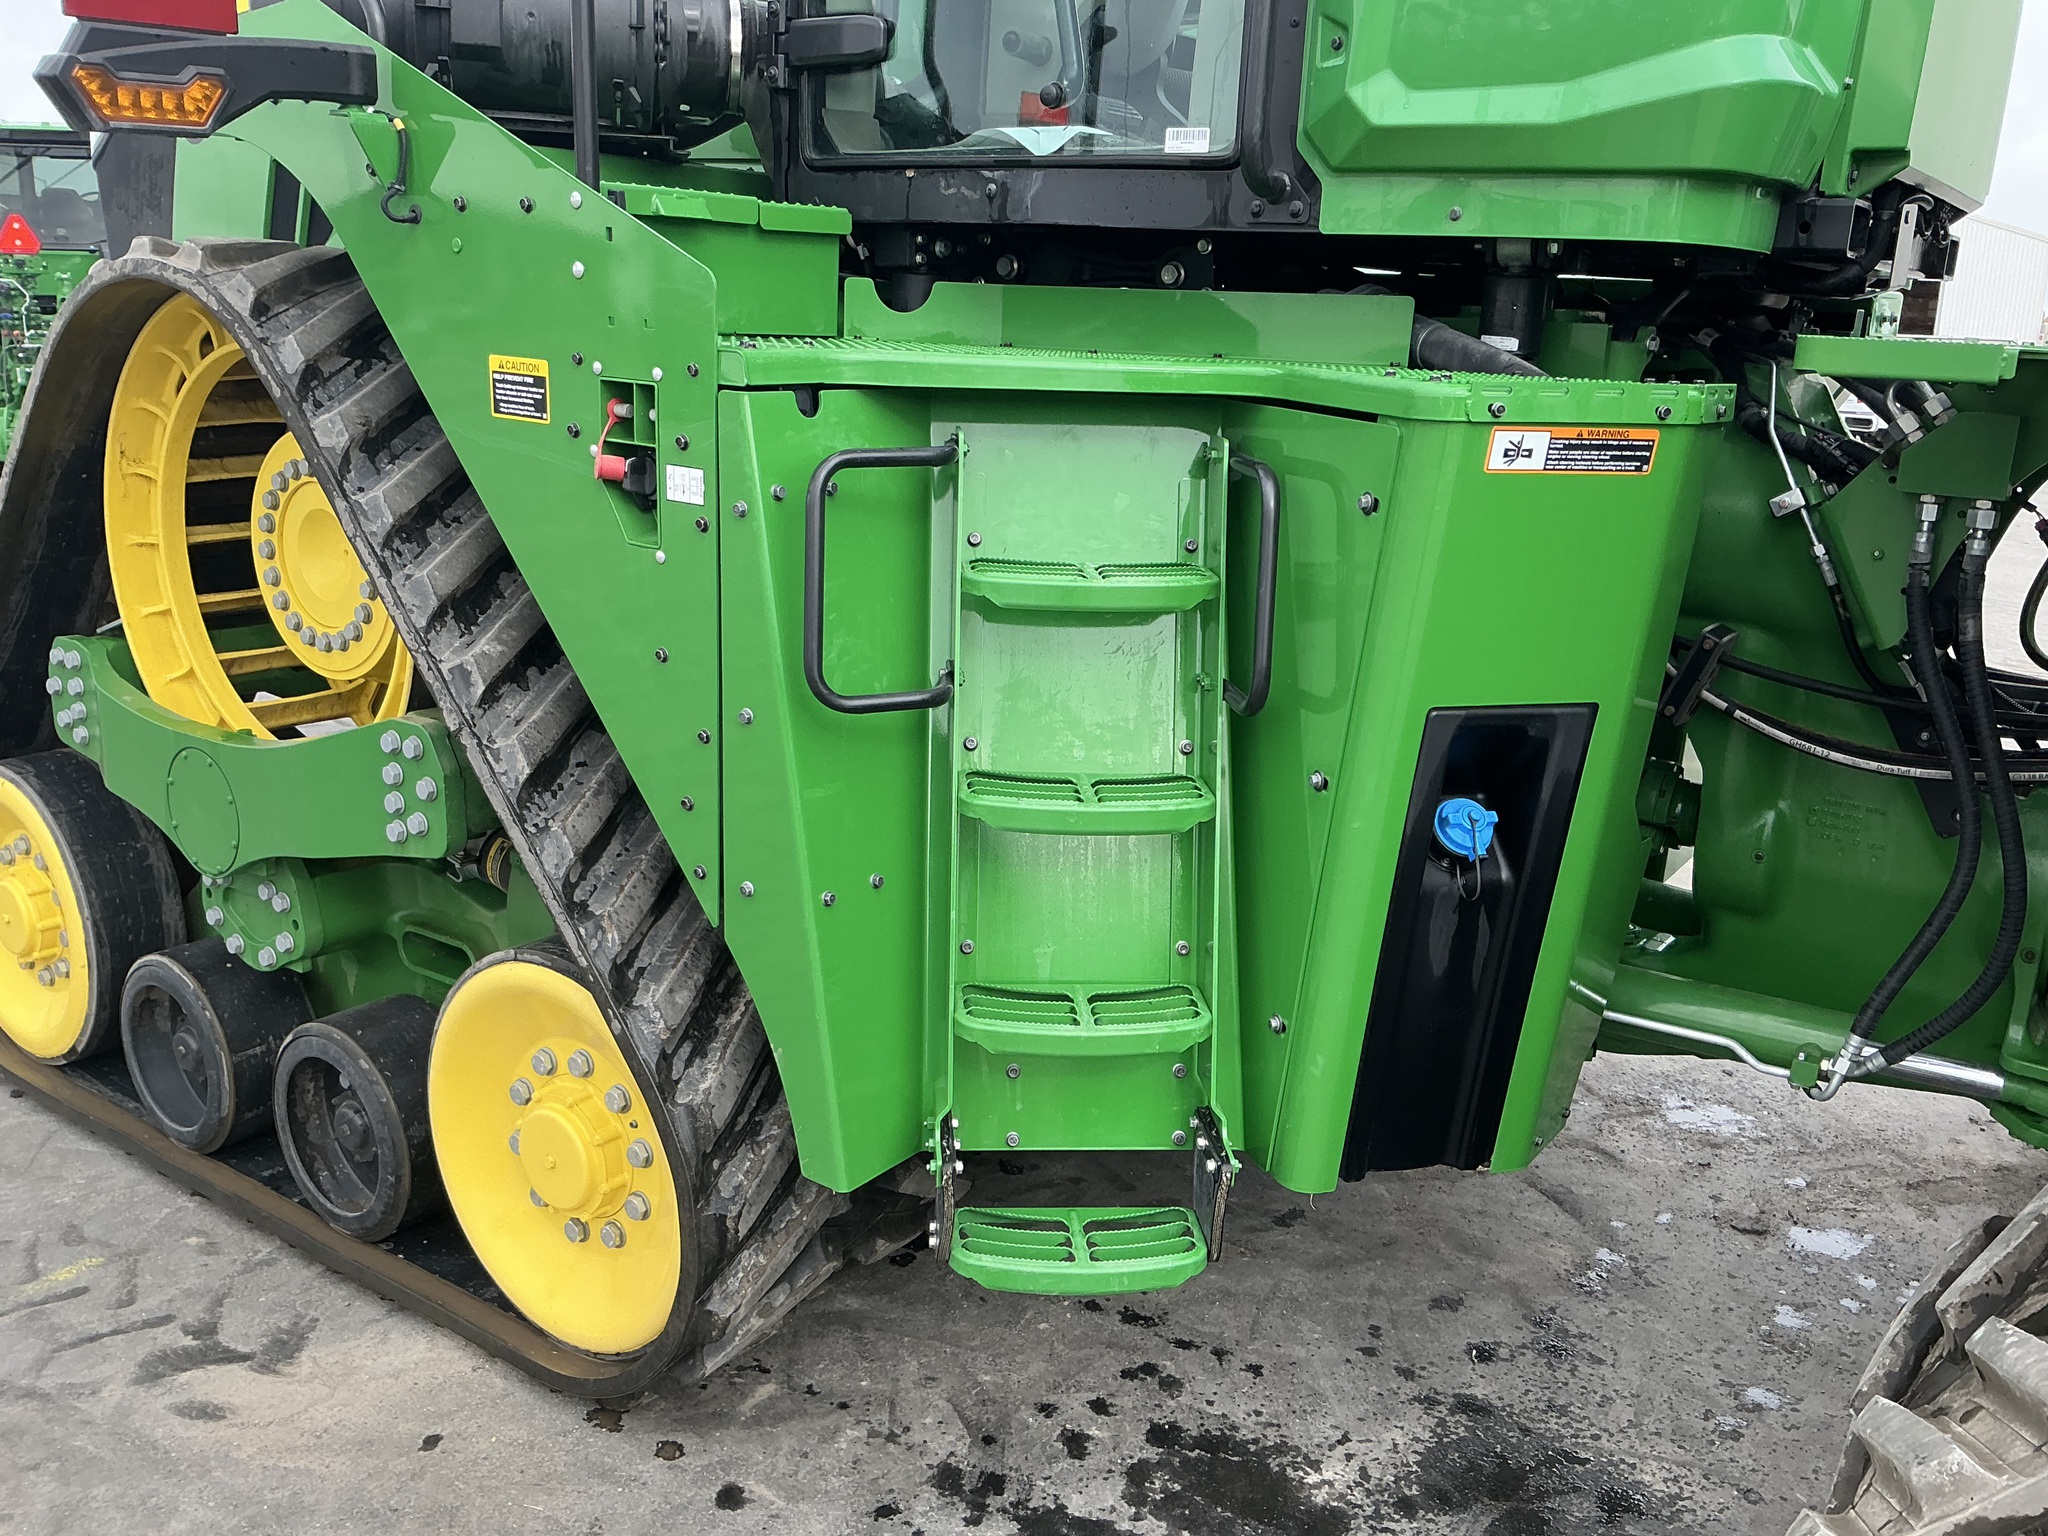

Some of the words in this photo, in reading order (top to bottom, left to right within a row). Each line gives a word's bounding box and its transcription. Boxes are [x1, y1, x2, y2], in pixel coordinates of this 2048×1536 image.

[505, 360, 540, 373] CAUTION
[504, 374, 524, 382] PREVENT
[1588, 429, 1630, 438] WARNING
[1789, 738, 1831, 758] GH681-12
